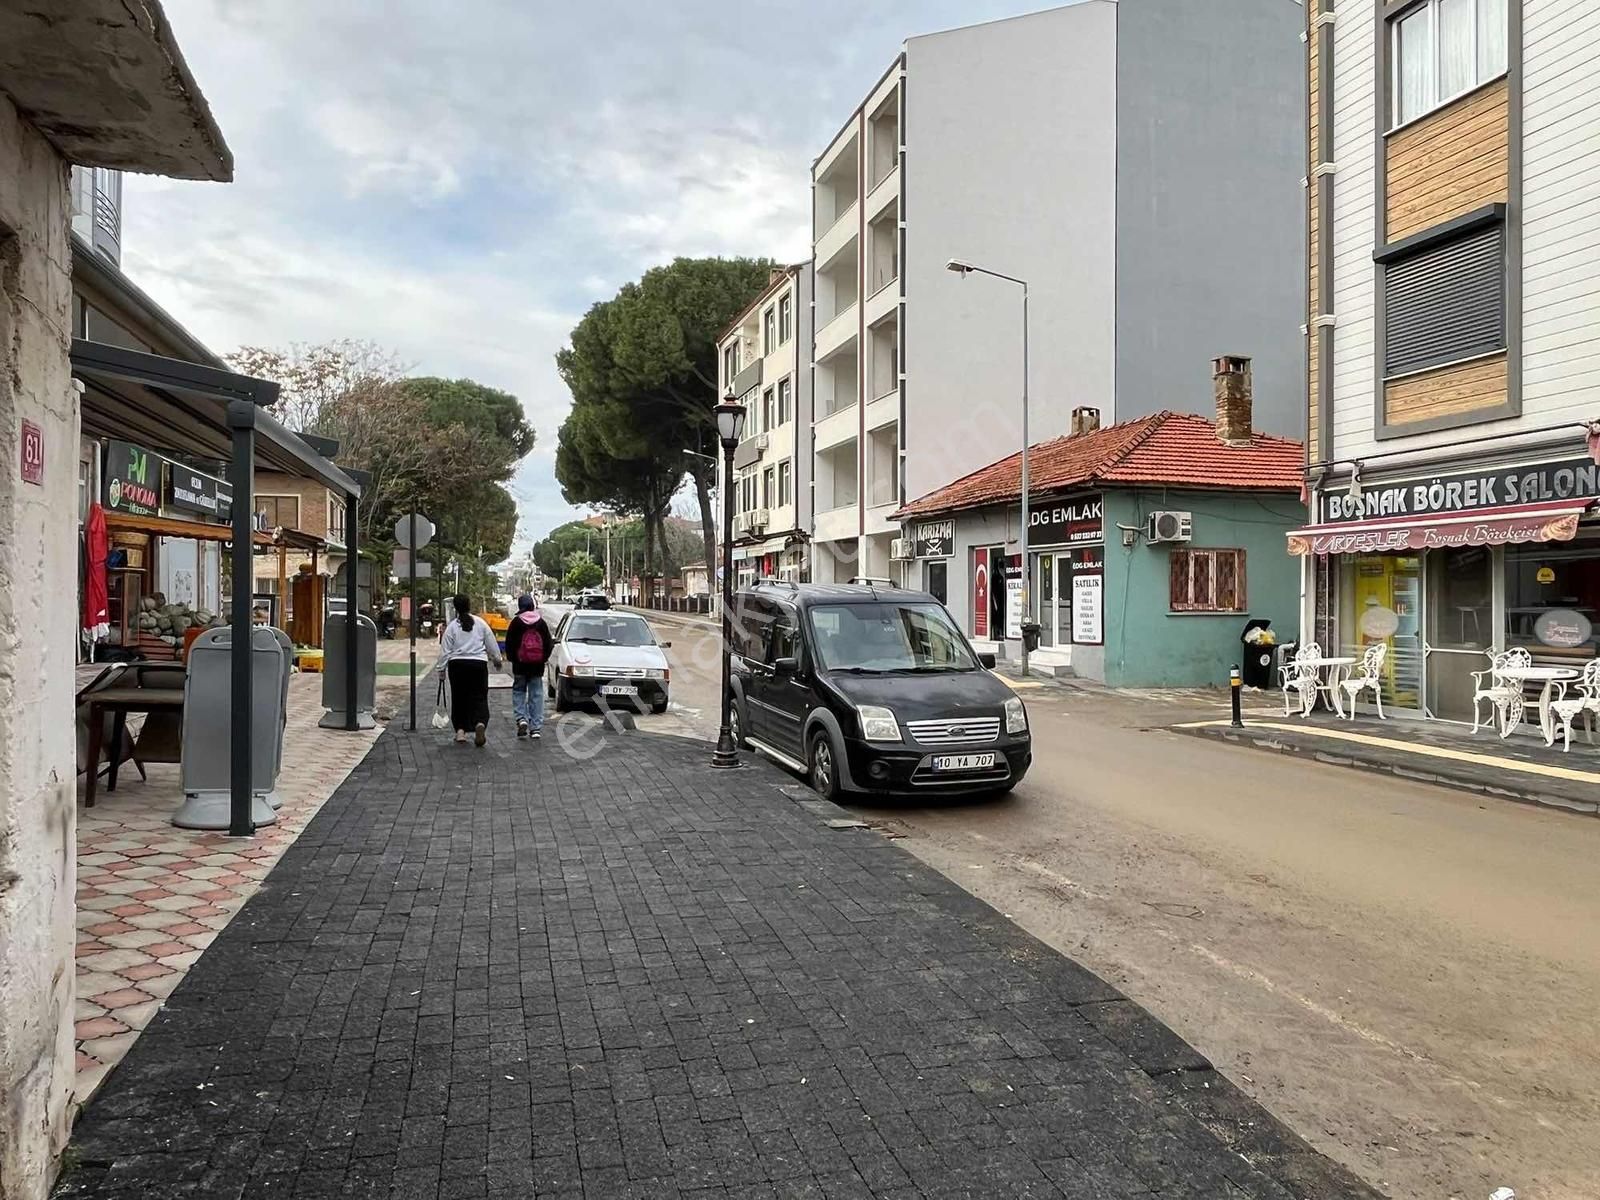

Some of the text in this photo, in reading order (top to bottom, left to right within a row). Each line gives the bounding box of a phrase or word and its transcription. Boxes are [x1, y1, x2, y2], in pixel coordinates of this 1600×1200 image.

[26, 434, 40, 464] 61
[1329, 465, 1600, 520] BOŞNAK BÖREK SALON
[1028, 502, 1102, 527] DG EMLAK
[1311, 524, 1539, 552] KARDEŞLER Boşnak Börekçisi
[940, 755, 993, 768] 10 YA 707
